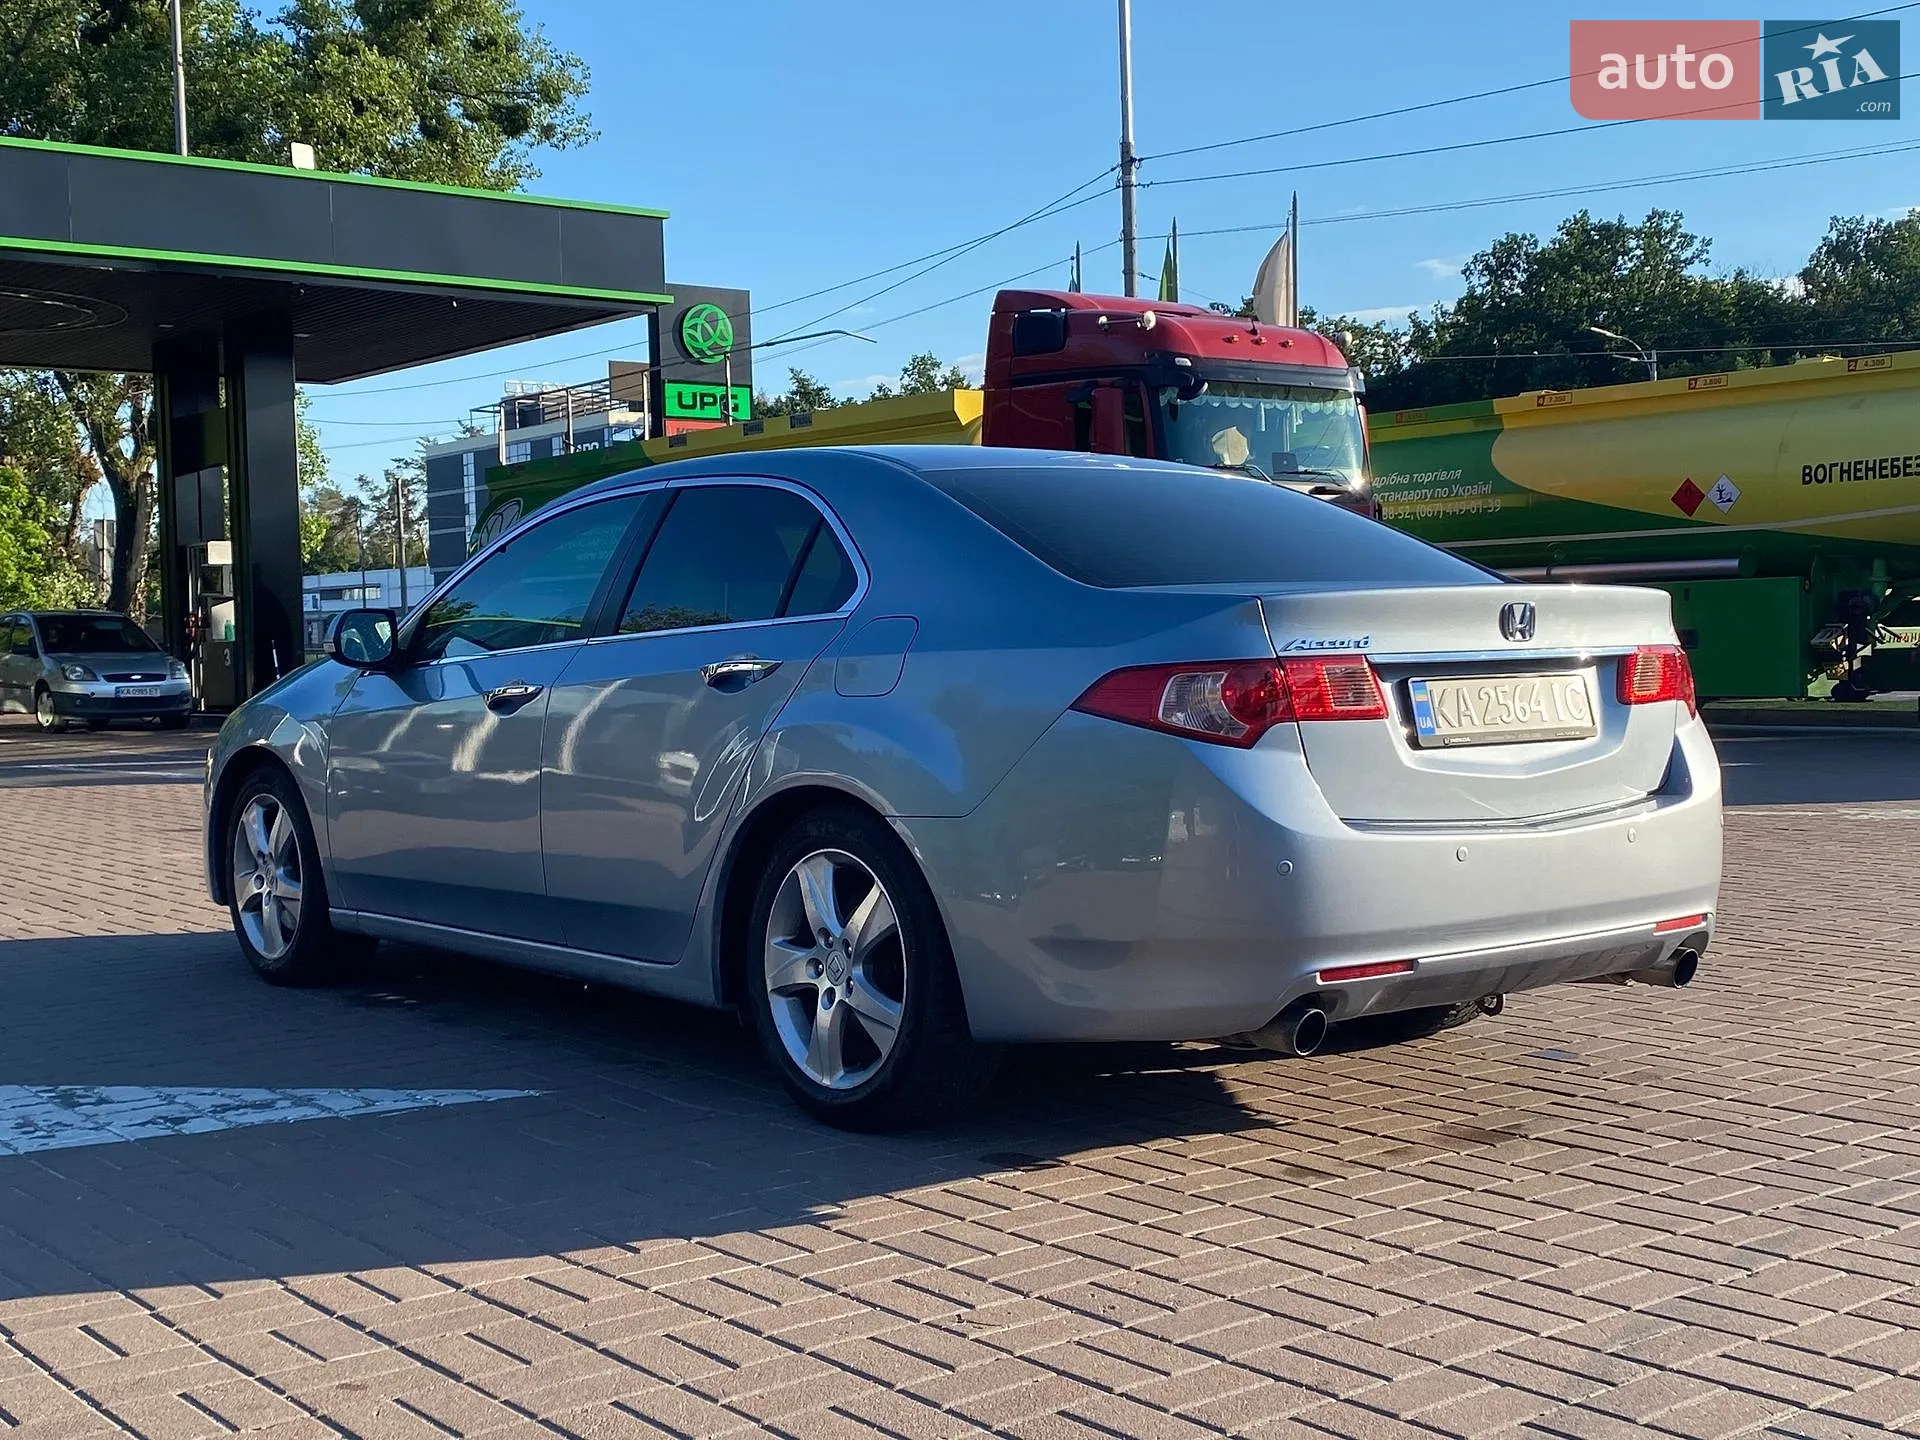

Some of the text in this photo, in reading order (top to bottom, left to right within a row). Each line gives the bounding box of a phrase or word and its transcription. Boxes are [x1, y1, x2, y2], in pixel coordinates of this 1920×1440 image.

[677, 391, 740, 413] UPG
[1413, 468, 1463, 485] торгівля
[1434, 486, 1450, 499] по
[1451, 481, 1493, 501] Україні
[1281, 634, 1370, 653] Accord
[1431, 687, 1480, 729] KA
[1479, 681, 1550, 726] 2564
[1418, 716, 1434, 730] UA
